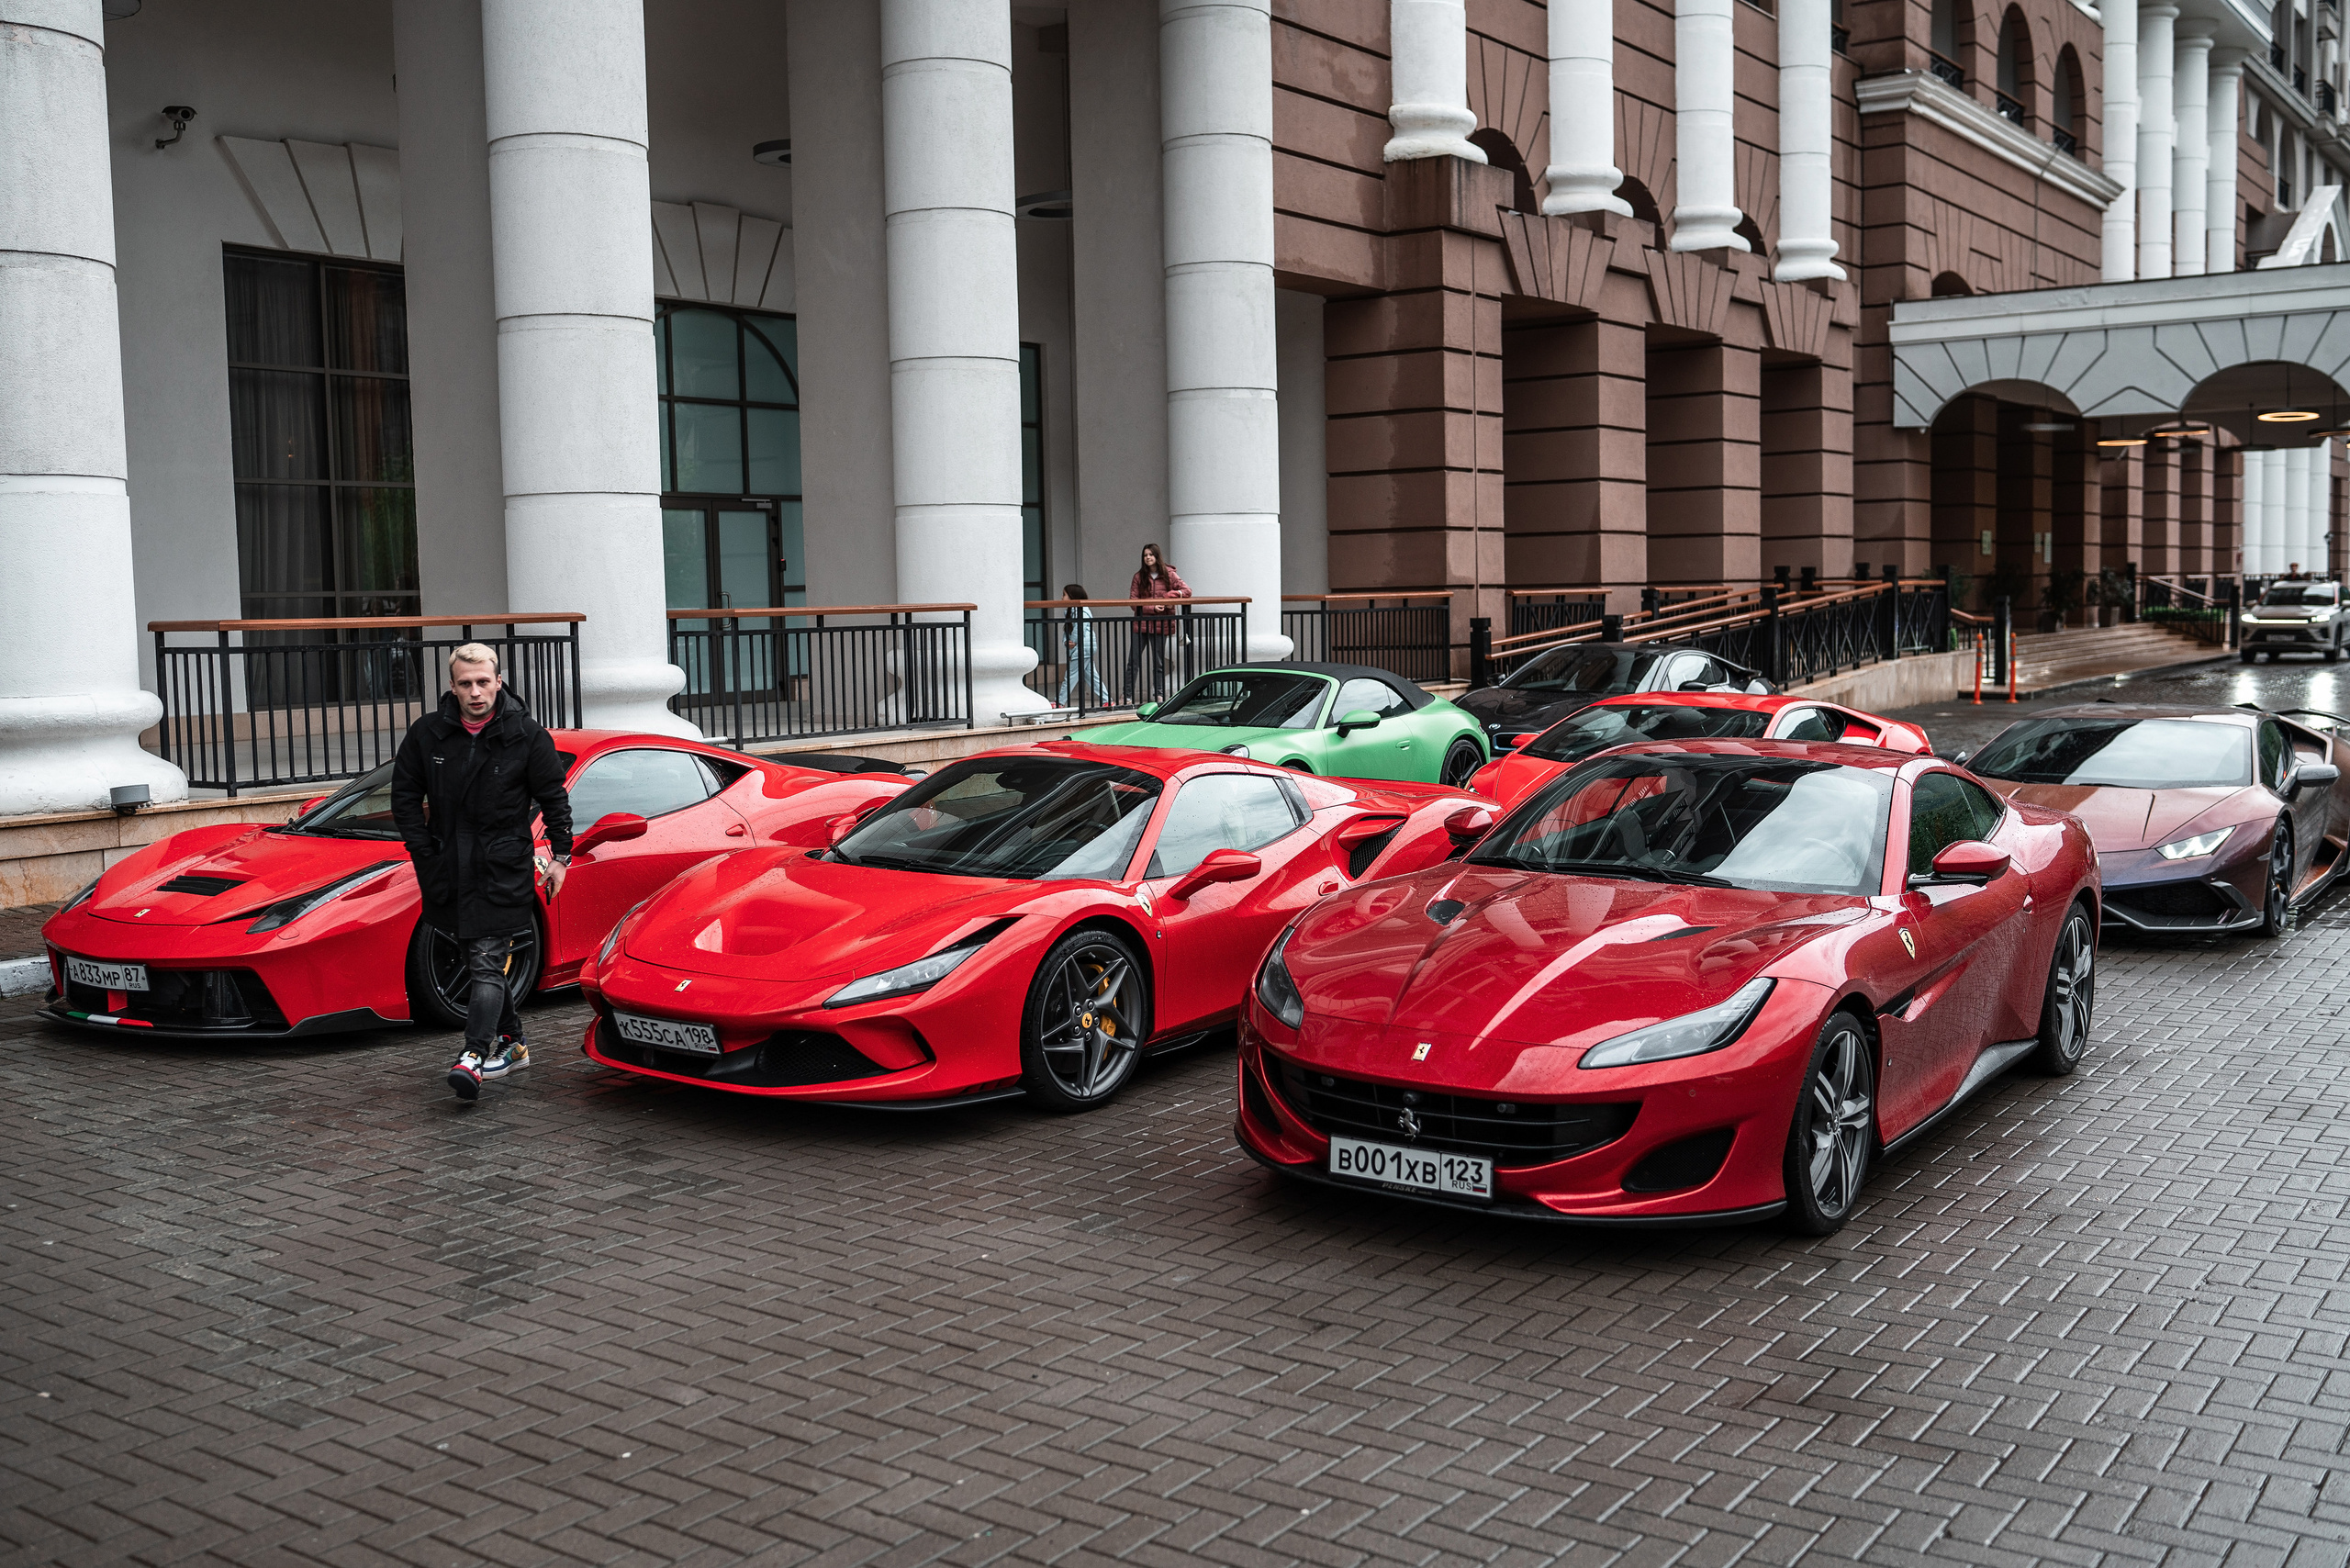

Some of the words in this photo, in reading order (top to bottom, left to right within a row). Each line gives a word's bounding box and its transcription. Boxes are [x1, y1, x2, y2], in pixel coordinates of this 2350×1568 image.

[124, 967, 140, 982] 87
[685, 1026, 711, 1044] 198
[1443, 1158, 1483, 1183] 123
[1451, 1180, 1472, 1191] RUS
